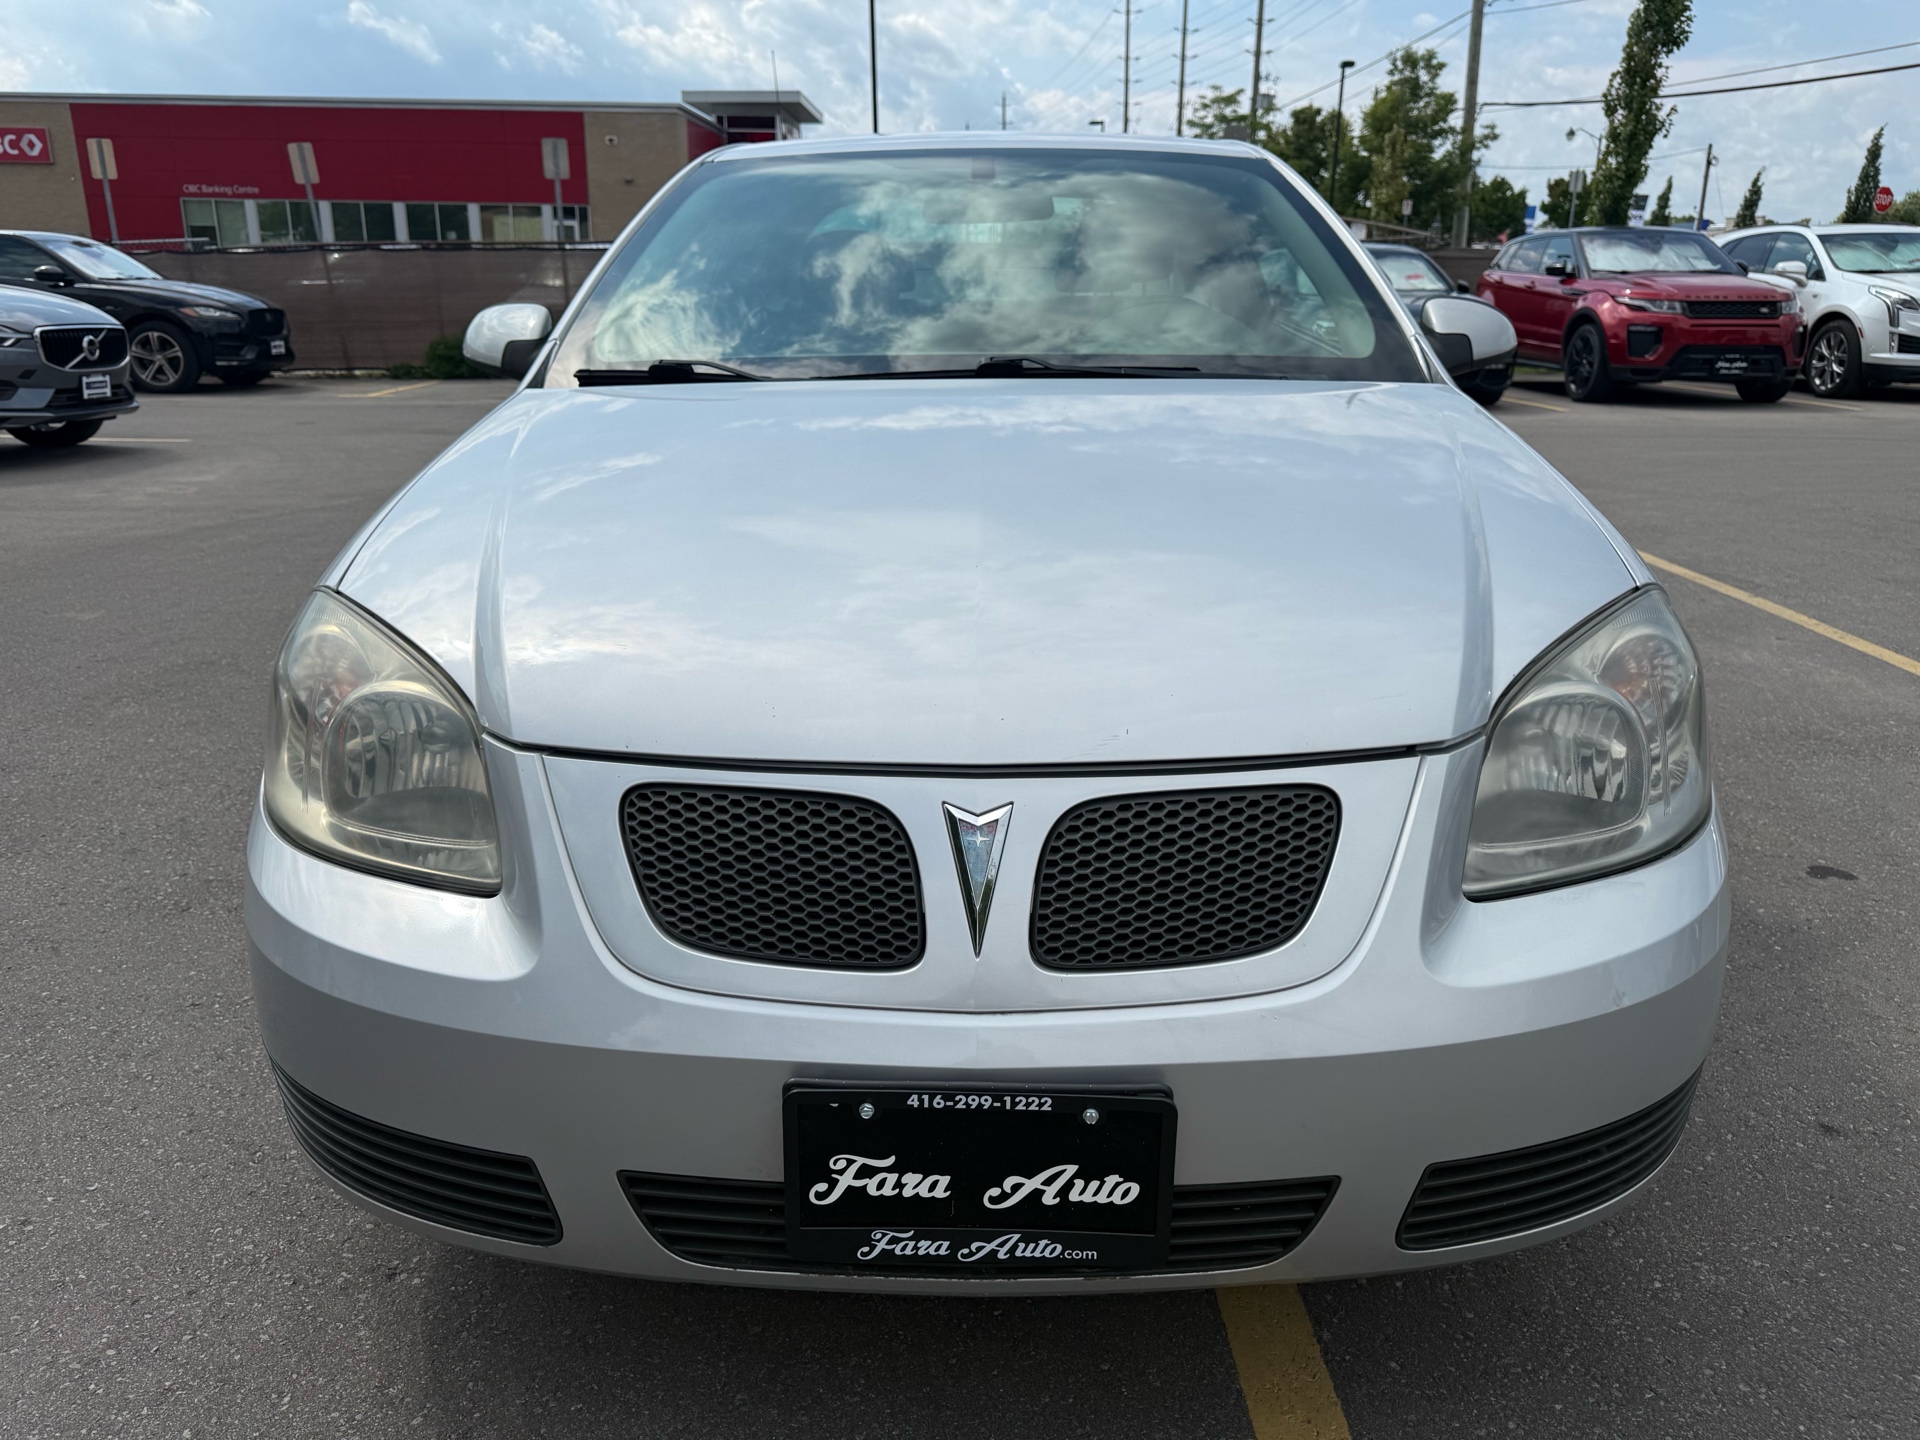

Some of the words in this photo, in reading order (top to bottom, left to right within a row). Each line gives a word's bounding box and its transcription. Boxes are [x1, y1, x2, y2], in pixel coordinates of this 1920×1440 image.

[1875, 193, 1893, 206] STOP
[906, 1093, 1053, 1112] 416-299-1222
[808, 1153, 952, 1205] Fara
[982, 1164, 1141, 1210] Auto
[856, 1229, 951, 1260] Fara
[957, 1233, 1098, 1262] Auto.com
